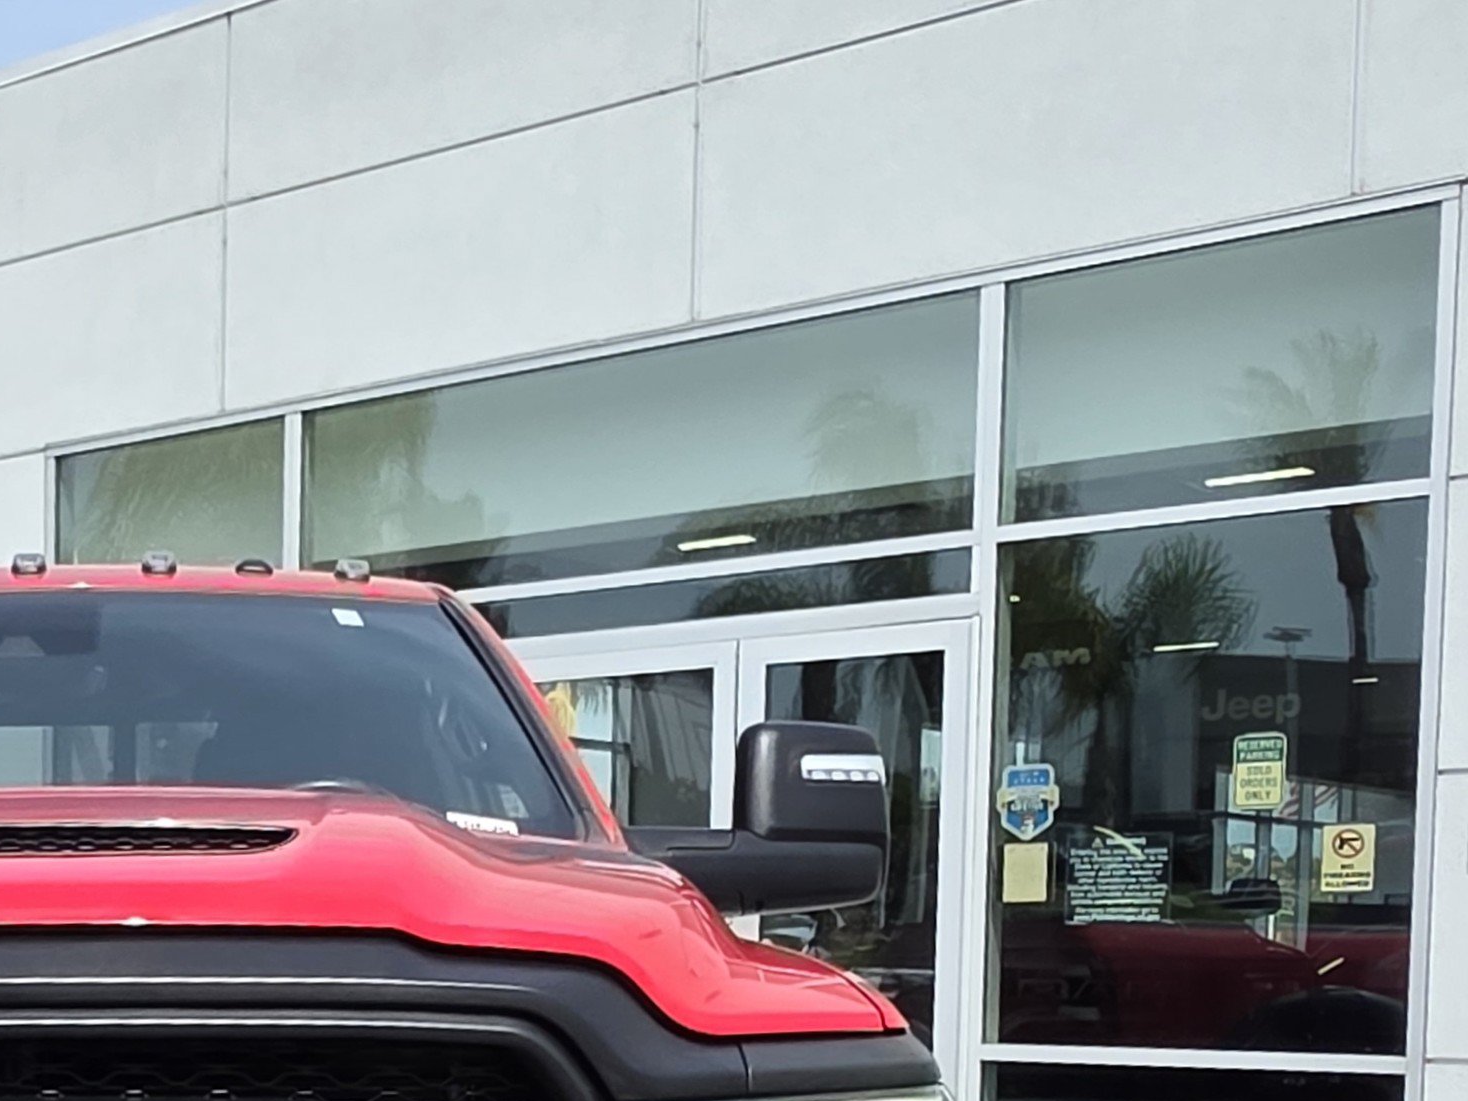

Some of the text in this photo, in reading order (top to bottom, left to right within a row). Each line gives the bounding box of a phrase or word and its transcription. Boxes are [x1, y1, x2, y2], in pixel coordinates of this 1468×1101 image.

[1201, 688, 1302, 725] Jeep
[1239, 750, 1280, 761] PARKING
[1239, 776, 1278, 789] ORDERS
[1244, 790, 1272, 802] ONLY
